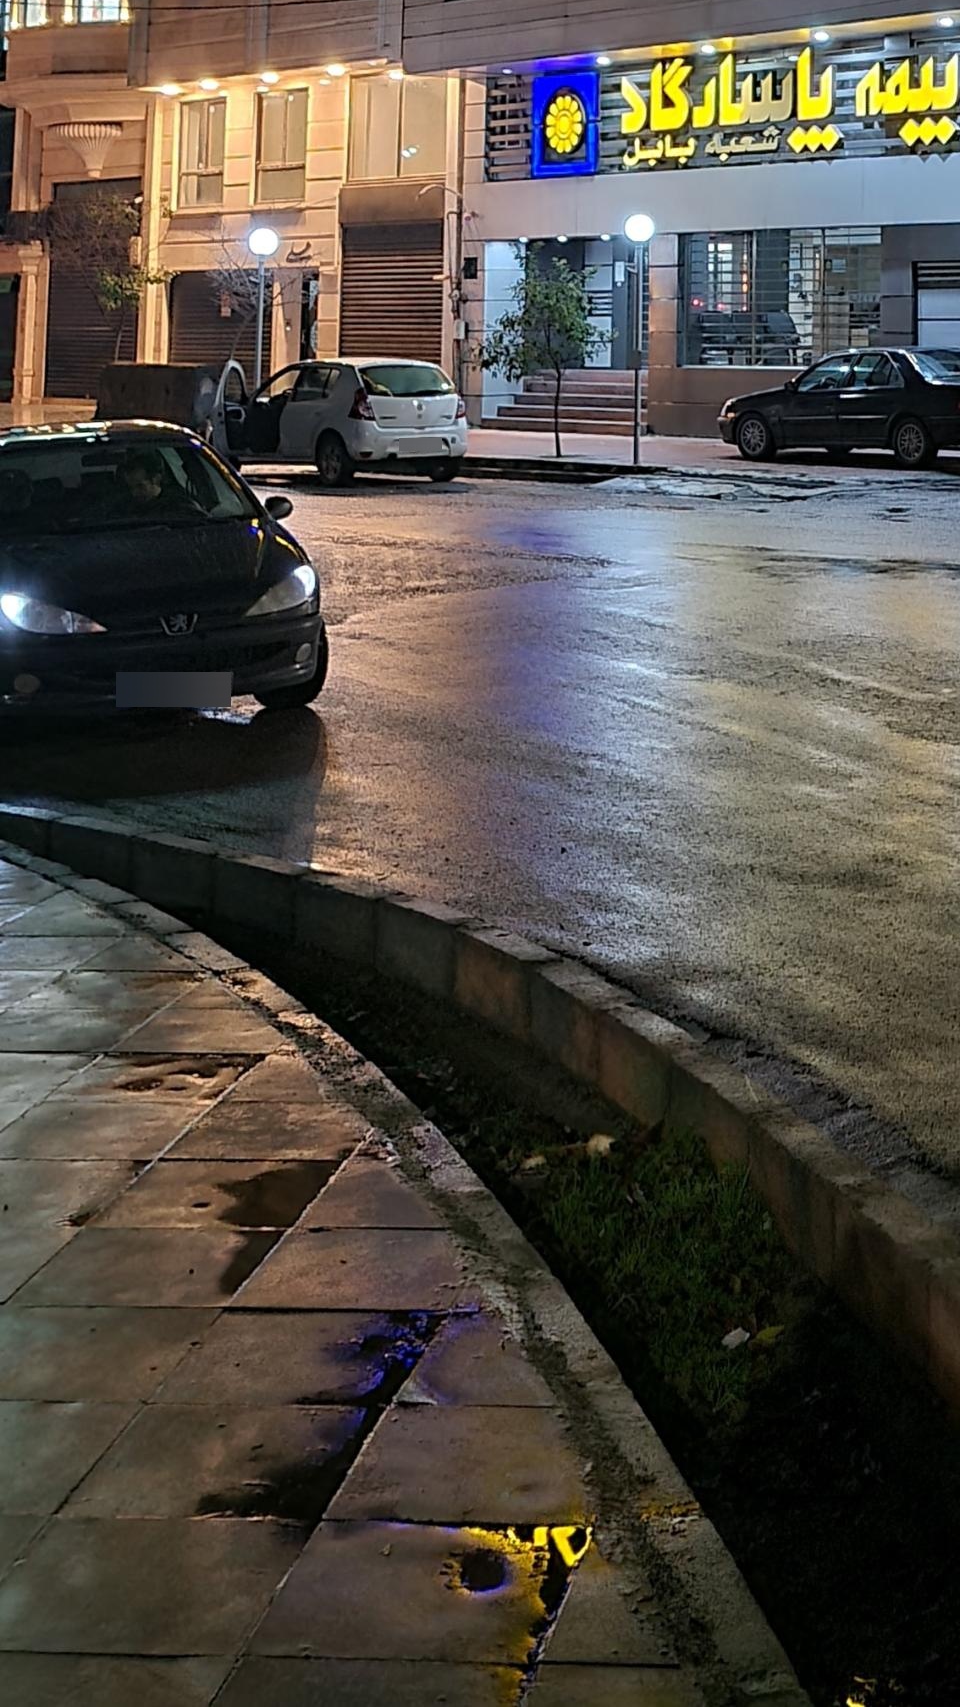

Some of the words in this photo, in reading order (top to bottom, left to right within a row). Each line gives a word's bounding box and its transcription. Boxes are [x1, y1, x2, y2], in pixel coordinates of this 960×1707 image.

[620, 47, 842, 154] پاسارگاد
[622, 133, 696, 168] بابل
[704, 125, 781, 162] شعبه
